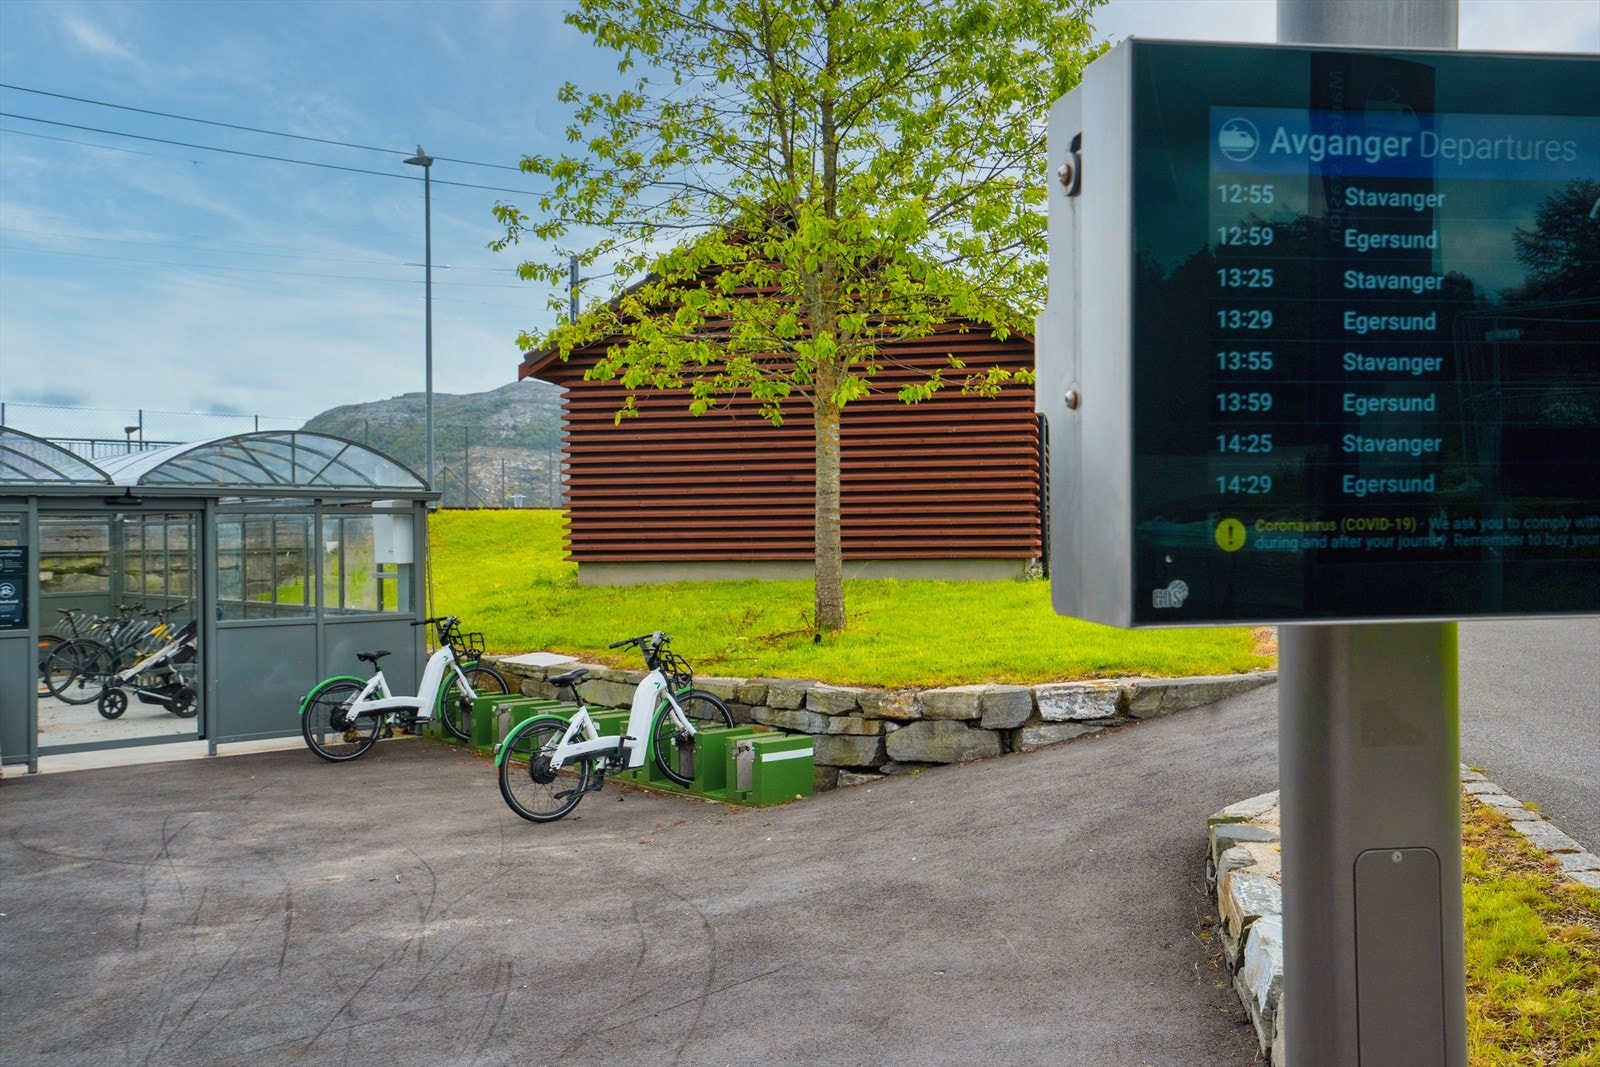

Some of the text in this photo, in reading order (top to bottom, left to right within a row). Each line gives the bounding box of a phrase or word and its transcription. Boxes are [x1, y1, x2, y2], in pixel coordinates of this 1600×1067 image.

[1269, 127, 1578, 163] Avganger Departures
[1216, 184, 1274, 205] 12:55
[1344, 186, 1446, 212] Stavanger
[1216, 226, 1438, 254] 12:59 Egersund
[1216, 268, 1445, 293] 13:25 Stavanger
[1216, 309, 1437, 335] 13:29 Egersund
[1216, 351, 1444, 376] 13:55 Stavanger
[1216, 392, 1436, 417] 13:59 Egersund
[1216, 433, 1443, 457] 14:25 Stavanger
[1216, 474, 1436, 498] 14:29 Egersund
[1254, 519, 1337, 532] Coronavirus
[1340, 517, 1417, 533] (COVID-19)
[1428, 517, 1449, 530] We
[1453, 516, 1477, 529] ask
[1480, 519, 1503, 533] you
[1507, 516, 1521, 529] to
[1523, 515, 1572, 532] comply
[1255, 535, 1298, 553] during
[1302, 535, 1328, 548] and
[1330, 535, 1362, 548] after
[1365, 537, 1395, 551] your
[1454, 533, 1524, 547] Remember
[1527, 533, 1541, 545] to
[1544, 532, 1569, 548] buy
